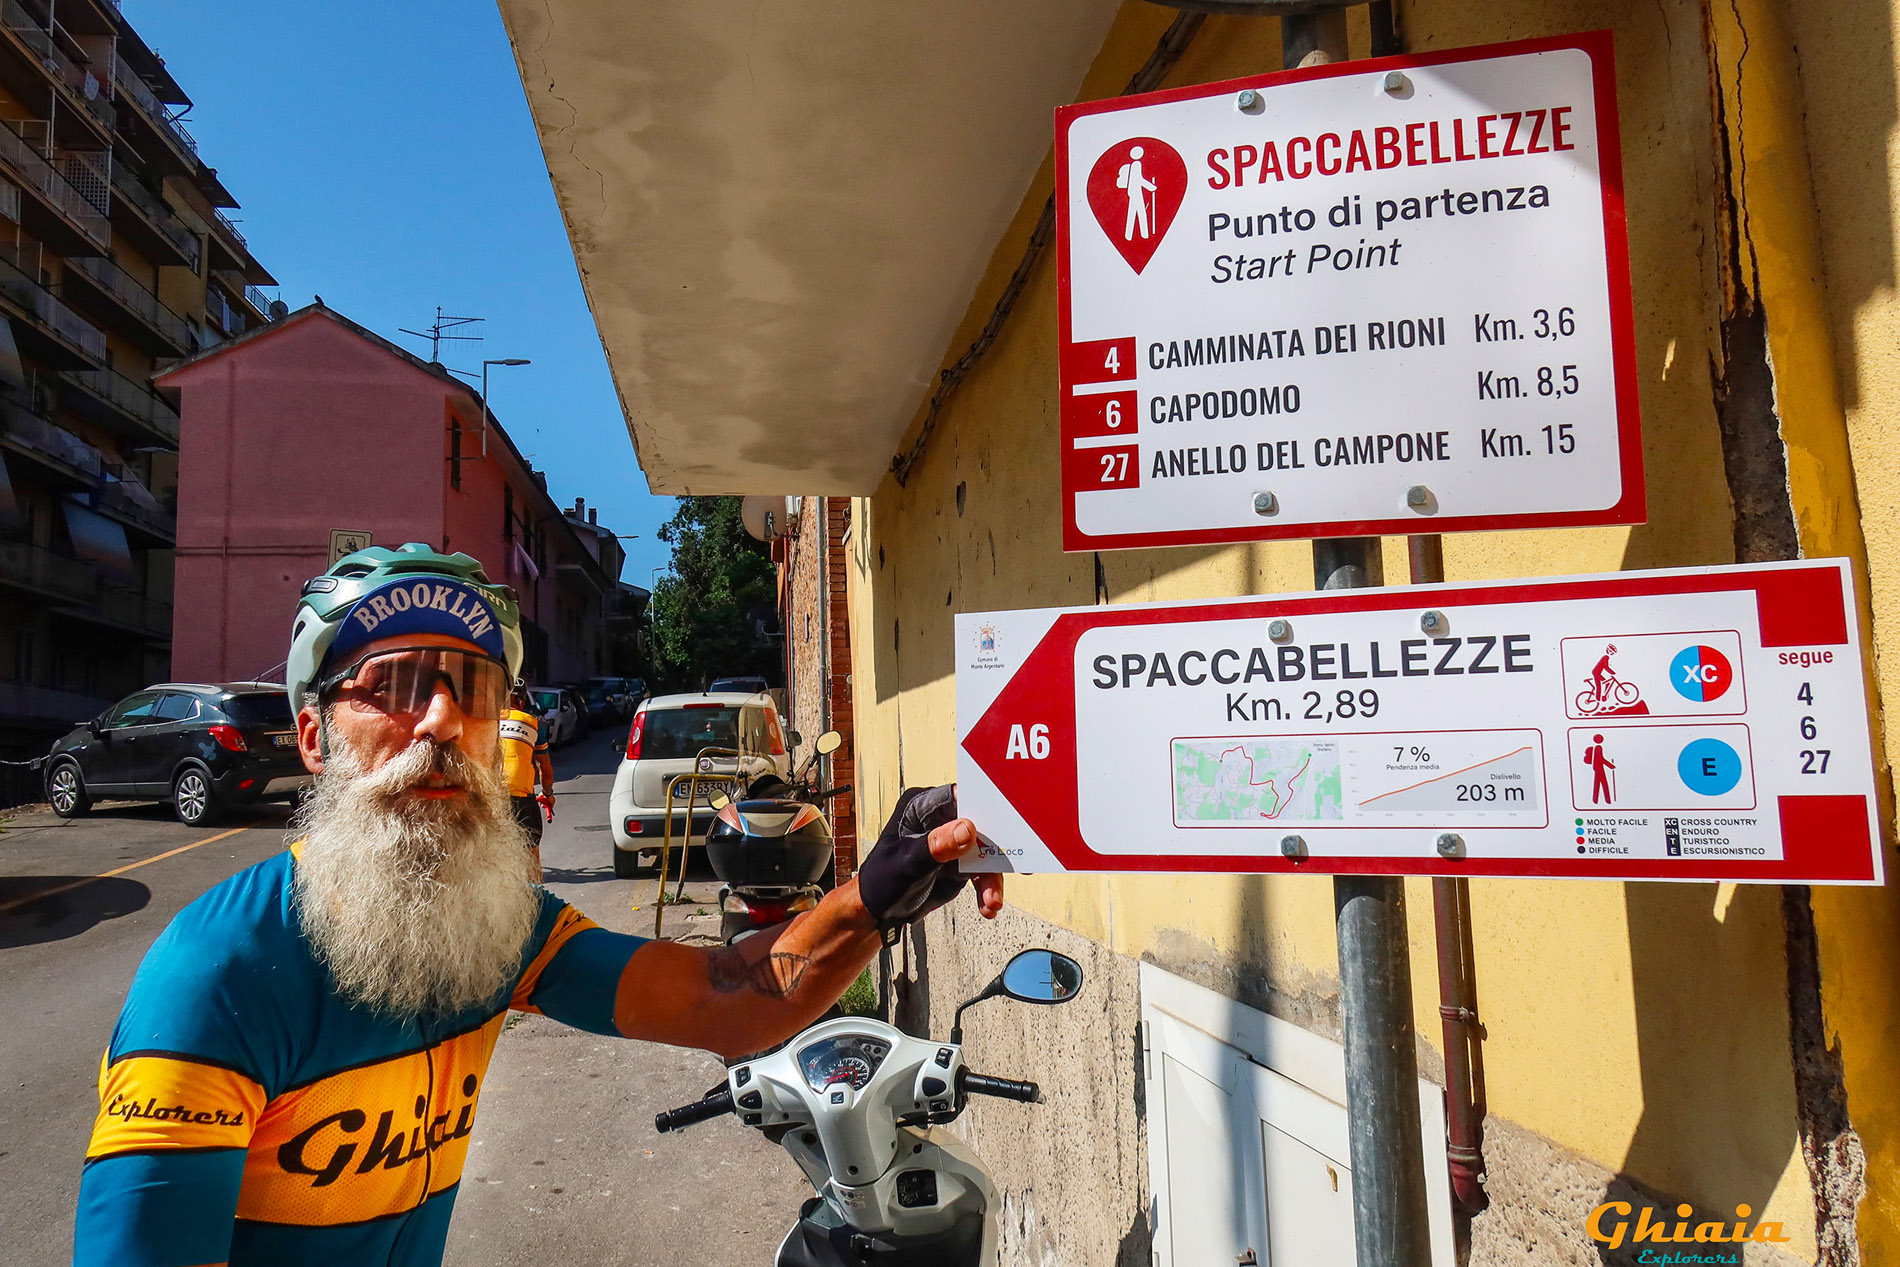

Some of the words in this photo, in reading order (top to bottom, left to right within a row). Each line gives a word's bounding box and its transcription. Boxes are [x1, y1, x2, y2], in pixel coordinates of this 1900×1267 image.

[1206, 105, 1575, 191] SPACCABELLEZZE
[1208, 204, 1316, 242] Punto
[1328, 194, 1362, 228] di
[1375, 183, 1550, 231] partenza
[1210, 248, 1296, 284] Start
[1306, 237, 1402, 274] Point
[1104, 346, 1120, 374] 4
[1149, 329, 1305, 370] CAMMINATA
[1315, 323, 1357, 355] DEI
[1367, 316, 1446, 351] RIONI
[1474, 313, 1525, 343] Km.
[1533, 306, 1575, 342] 3,6
[1105, 400, 1122, 428] 6
[1150, 384, 1301, 424] CAPODOMO
[1477, 370, 1528, 400] Km.
[1536, 364, 1579, 400] 8,5
[1100, 452, 1130, 483] 27
[1151, 444, 1247, 479] ANELLO
[1257, 440, 1305, 471] DEL
[1314, 430, 1450, 467] CAMPONE
[1480, 428, 1531, 458] Km.
[1541, 423, 1575, 454] 15
[353, 583, 494, 640] BROOKLYN
[1092, 634, 1534, 690] SPACCABELLEZZE
[1778, 650, 1834, 668] segue
[1682, 663, 1718, 684] XC
[1226, 692, 1291, 722] Km.
[1302, 688, 1380, 724] 2,89
[1797, 682, 1813, 706] 4
[500, 724, 530, 738] iaia
[1800, 715, 1817, 740] 6
[1005, 723, 1051, 760] A6
[1393, 746, 1405, 762] 7
[1410, 746, 1431, 762] %
[1386, 763, 1418, 771] Pendenza
[1702, 757, 1718, 776] E
[1799, 749, 1831, 774] 27
[1456, 784, 1497, 802] 203
[1505, 786, 1525, 802] m
[1586, 818, 1616, 826] MOLTO
[1618, 818, 1648, 826] FACILE
[1664, 818, 1678, 826] XC
[1681, 818, 1712, 826] CROSS
[1714, 818, 1757, 826] COUNTRY
[1681, 828, 1719, 836] ENDURO
[1670, 847, 1677, 855] E
[1683, 847, 1766, 855] ESCURSIONISTICO
[1682, 837, 1730, 845] TURISTICO
[107, 1093, 244, 1128] Explorers
[277, 1073, 478, 1188] Ghiai
